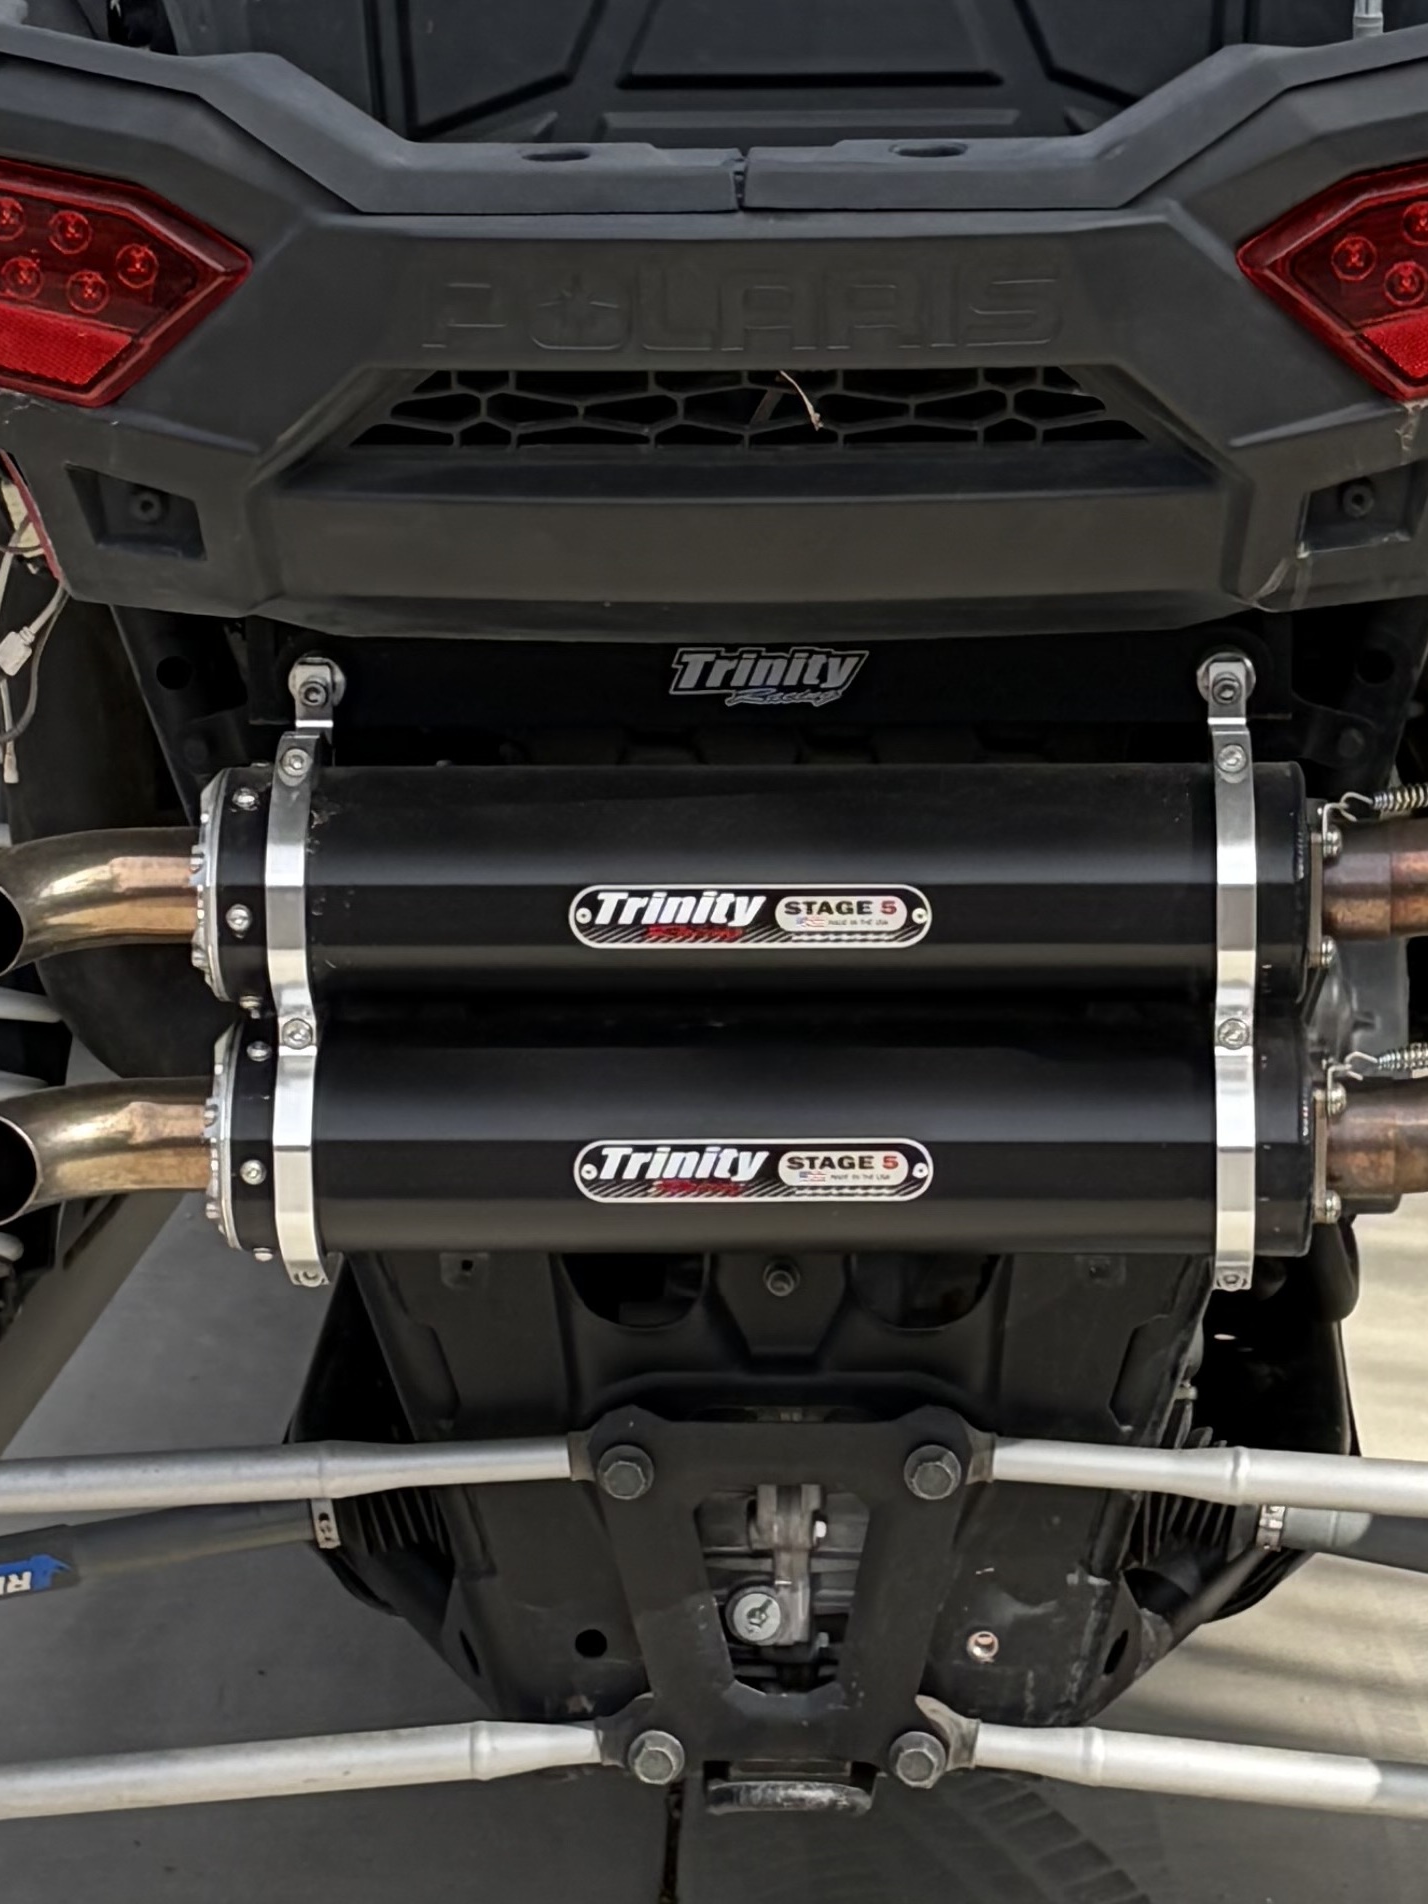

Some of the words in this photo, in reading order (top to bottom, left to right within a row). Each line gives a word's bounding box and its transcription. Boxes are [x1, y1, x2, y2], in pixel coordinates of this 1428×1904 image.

[420, 267, 1062, 352] POLARIS
[676, 652, 861, 689] Trinity
[594, 891, 767, 927] Trinity
[783, 900, 873, 915] STAGE
[880, 900, 897, 915] 5
[599, 1146, 770, 1181] Trinity
[786, 1156, 874, 1170] STAGE
[882, 1155, 899, 1170] 5
